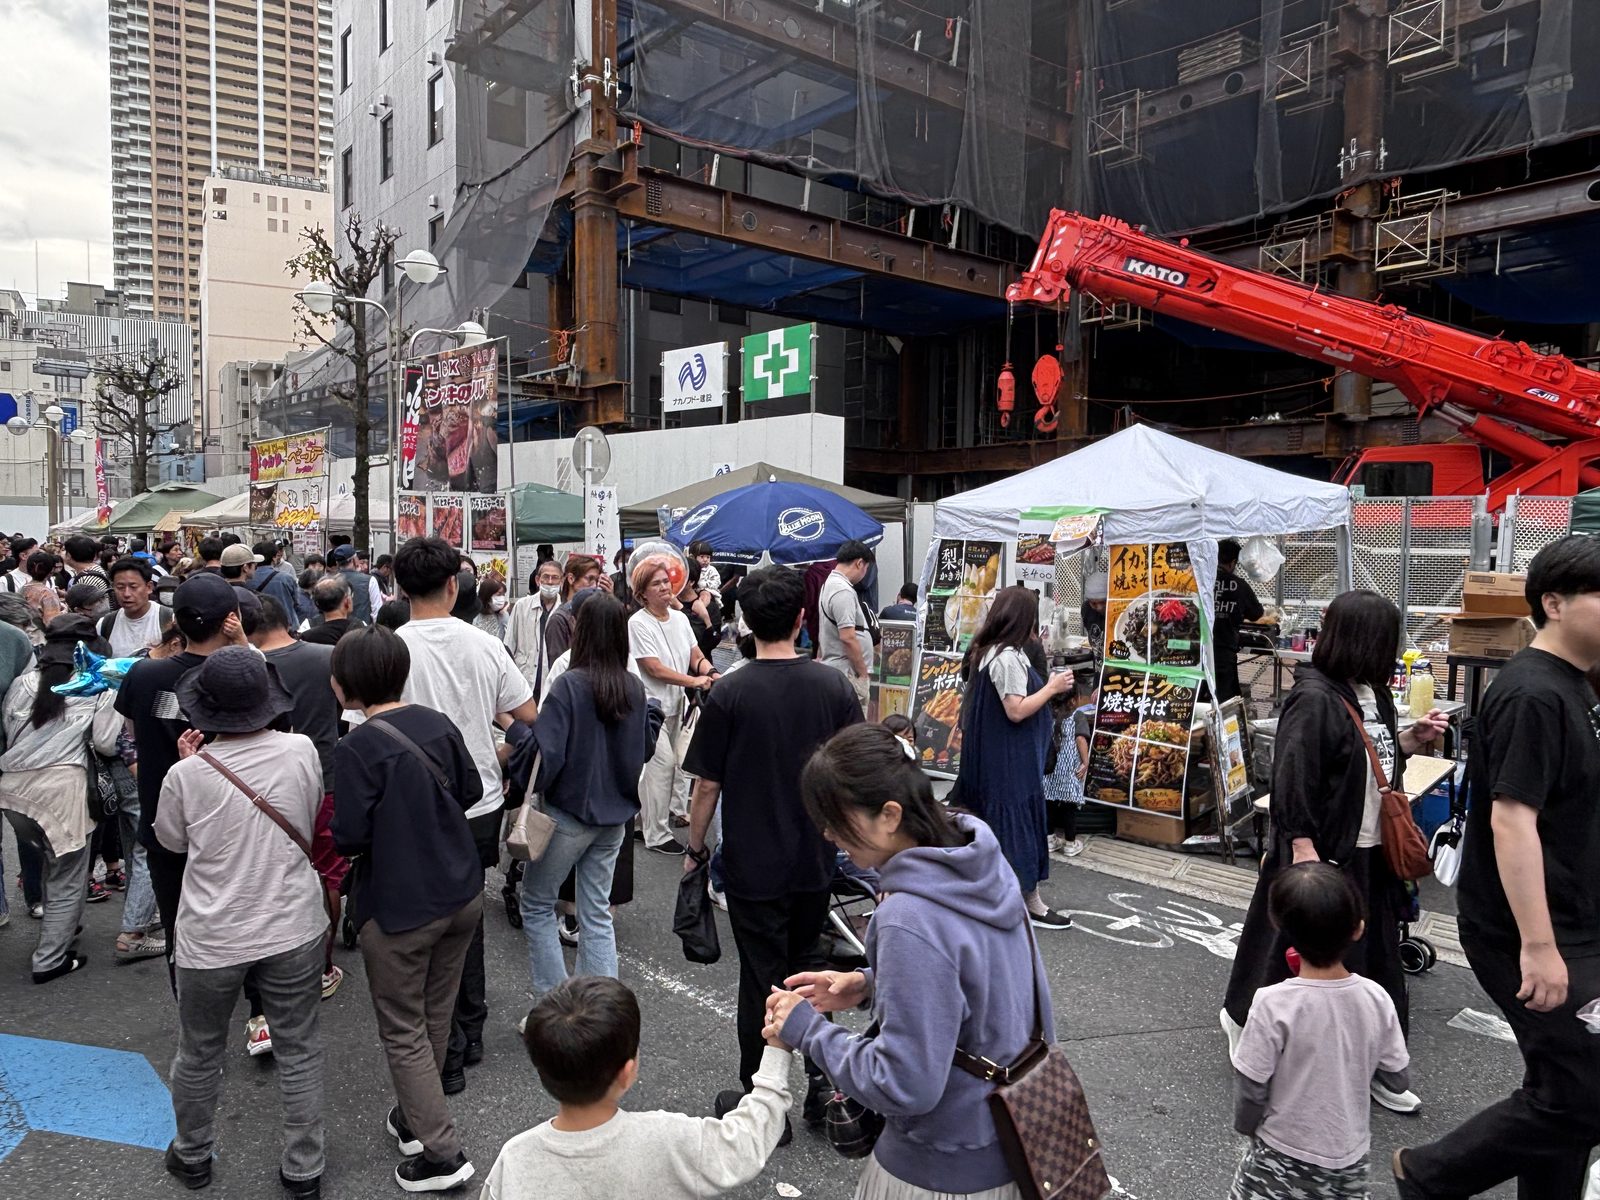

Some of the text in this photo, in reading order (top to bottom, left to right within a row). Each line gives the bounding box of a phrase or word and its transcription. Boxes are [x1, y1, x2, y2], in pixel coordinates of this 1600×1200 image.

[1127, 259, 1184, 285] KATO
[781, 512, 822, 534] BLUE MOON
[1021, 567, 1053, 580] ¥400
[1113, 570, 1169, 591] 焼きそば
[933, 673, 963, 690] ポテト
[1103, 674, 1174, 699] ニンニク
[1101, 691, 1169, 716] 焼きそば
